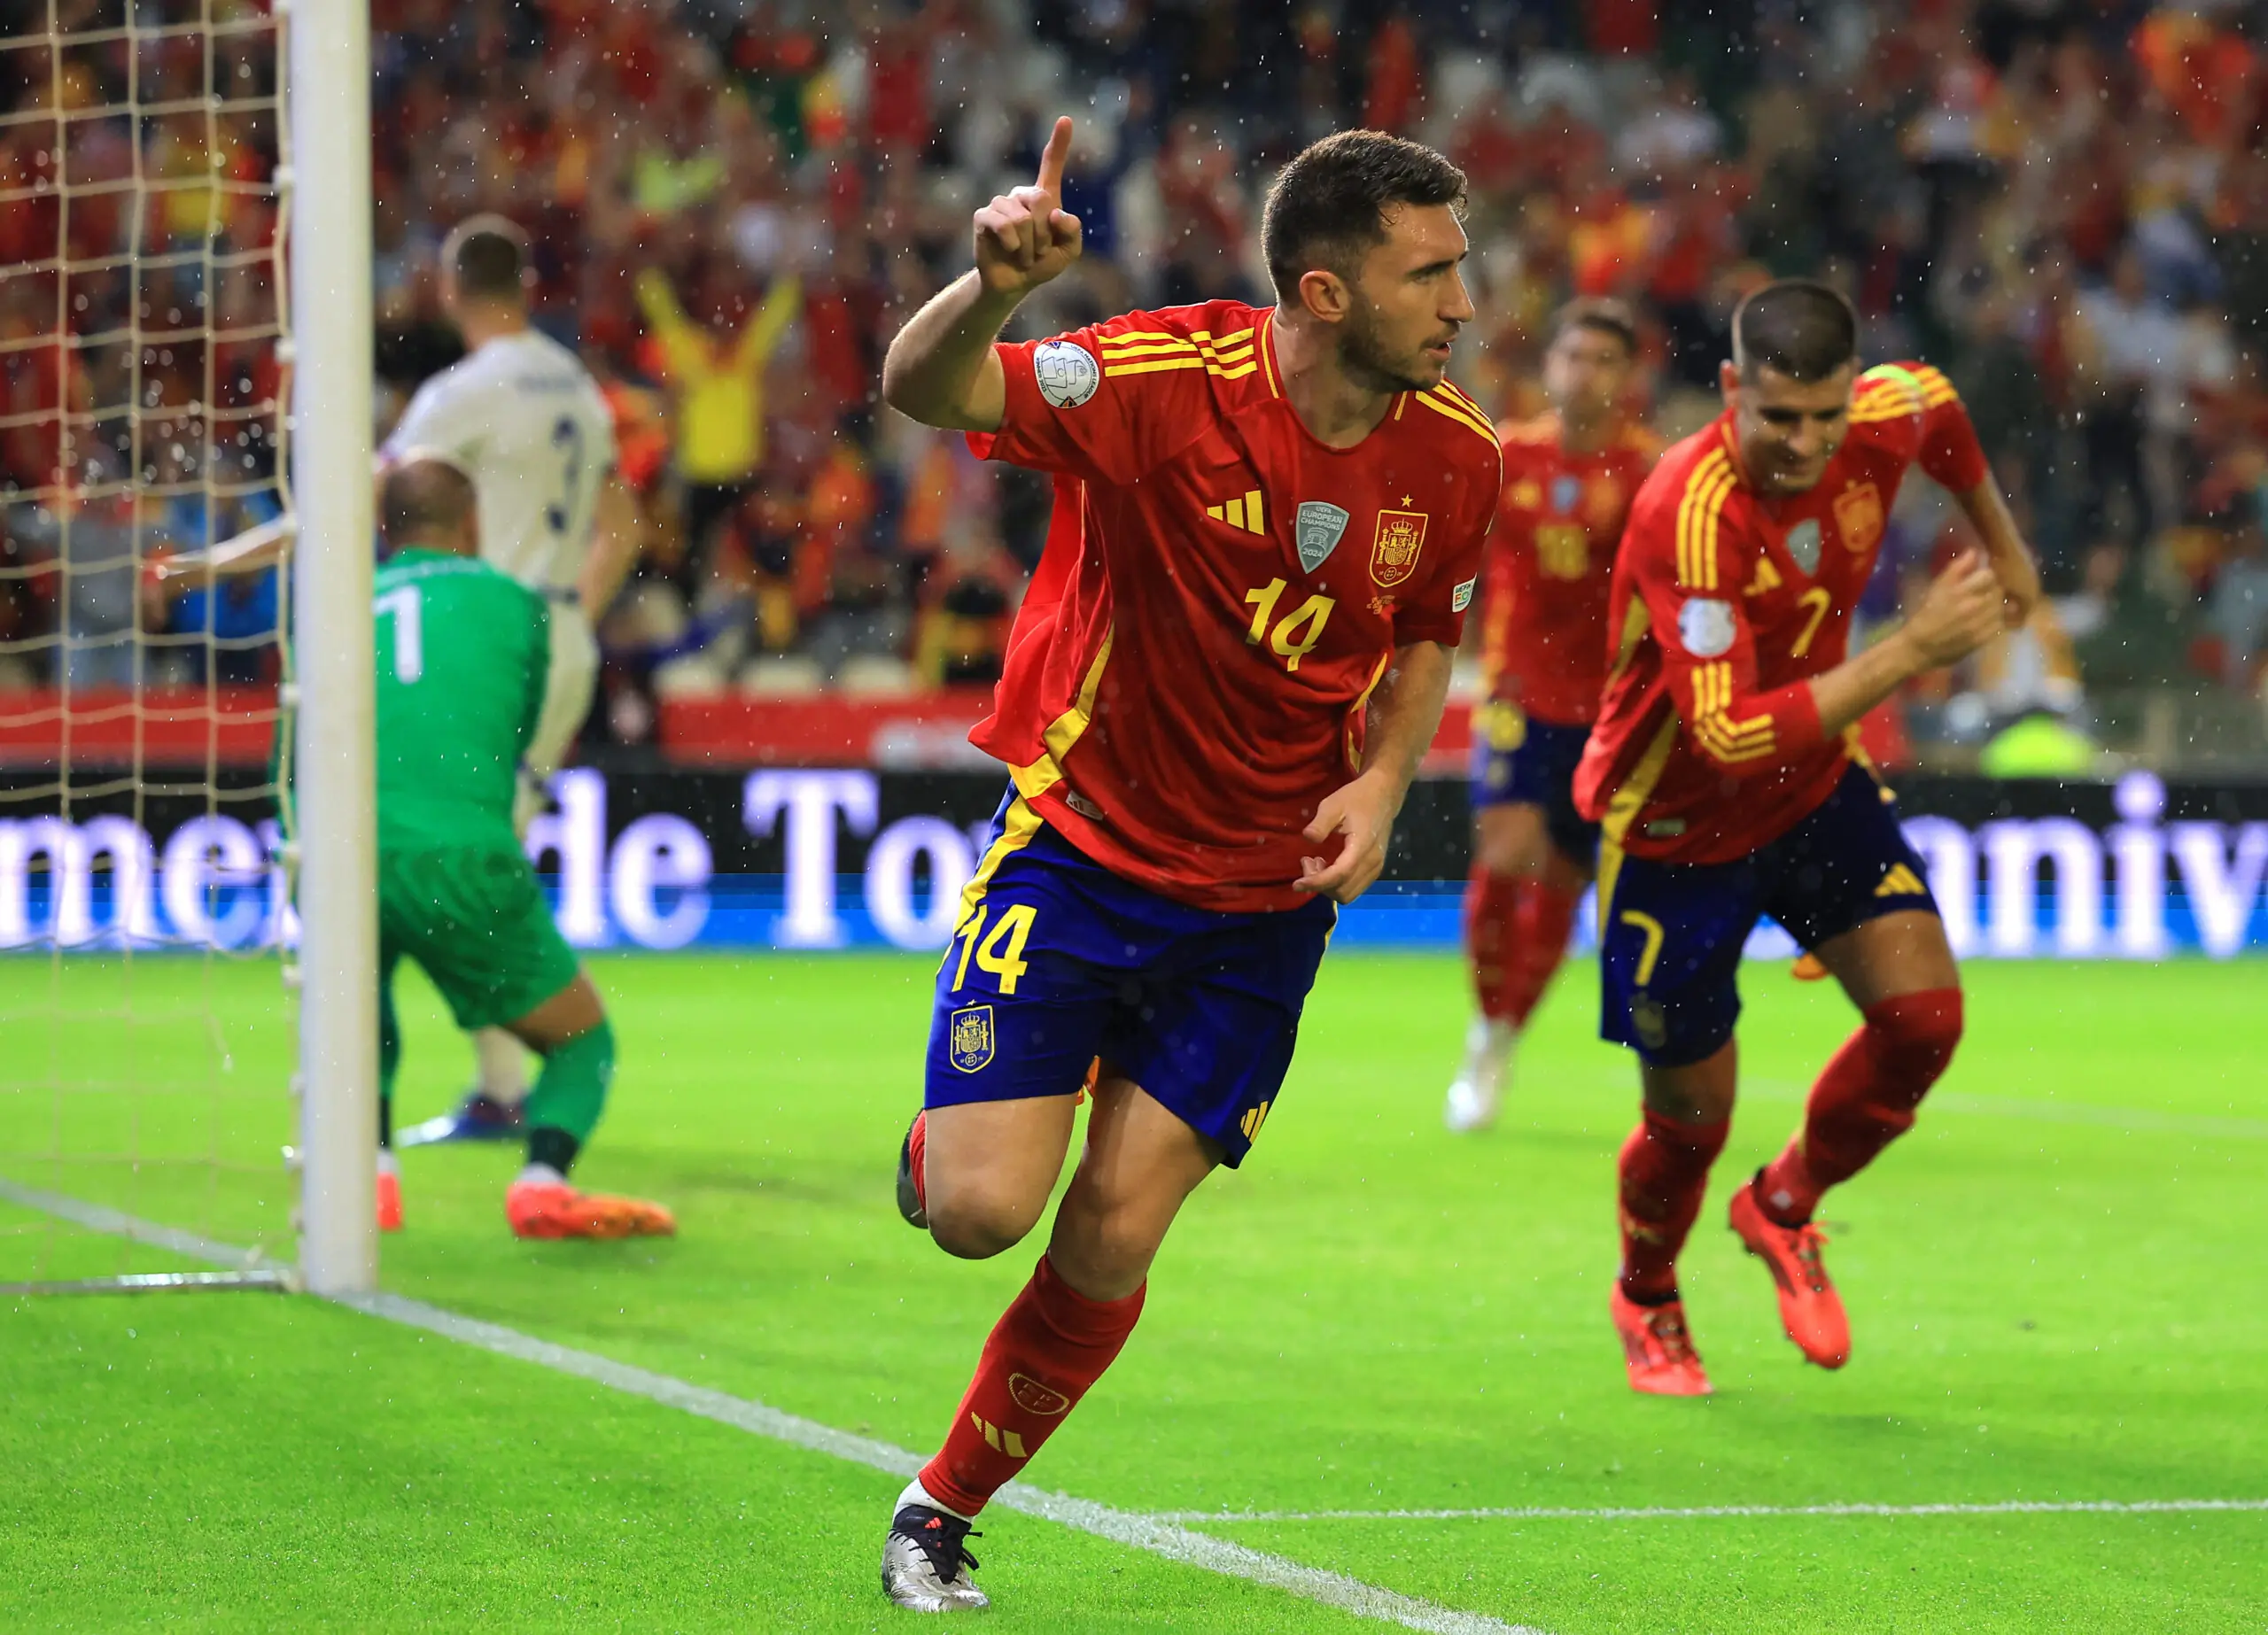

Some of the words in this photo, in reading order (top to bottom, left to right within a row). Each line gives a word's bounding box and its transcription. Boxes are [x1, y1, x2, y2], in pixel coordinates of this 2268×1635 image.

[1301, 517, 1341, 531] CHAMPIONS
[1302, 510, 1343, 524] EUROPEAN
[1316, 506, 1332, 515] UEFA
[1302, 547, 1324, 558] 2024
[371, 584, 423, 685] 1
[1244, 577, 1337, 672] 14
[1790, 585, 1832, 658] 7
[0, 813, 302, 949] me
[523, 765, 714, 950] de
[742, 767, 992, 951] To
[951, 903, 1038, 996] 14
[1619, 910, 1666, 987] 7
